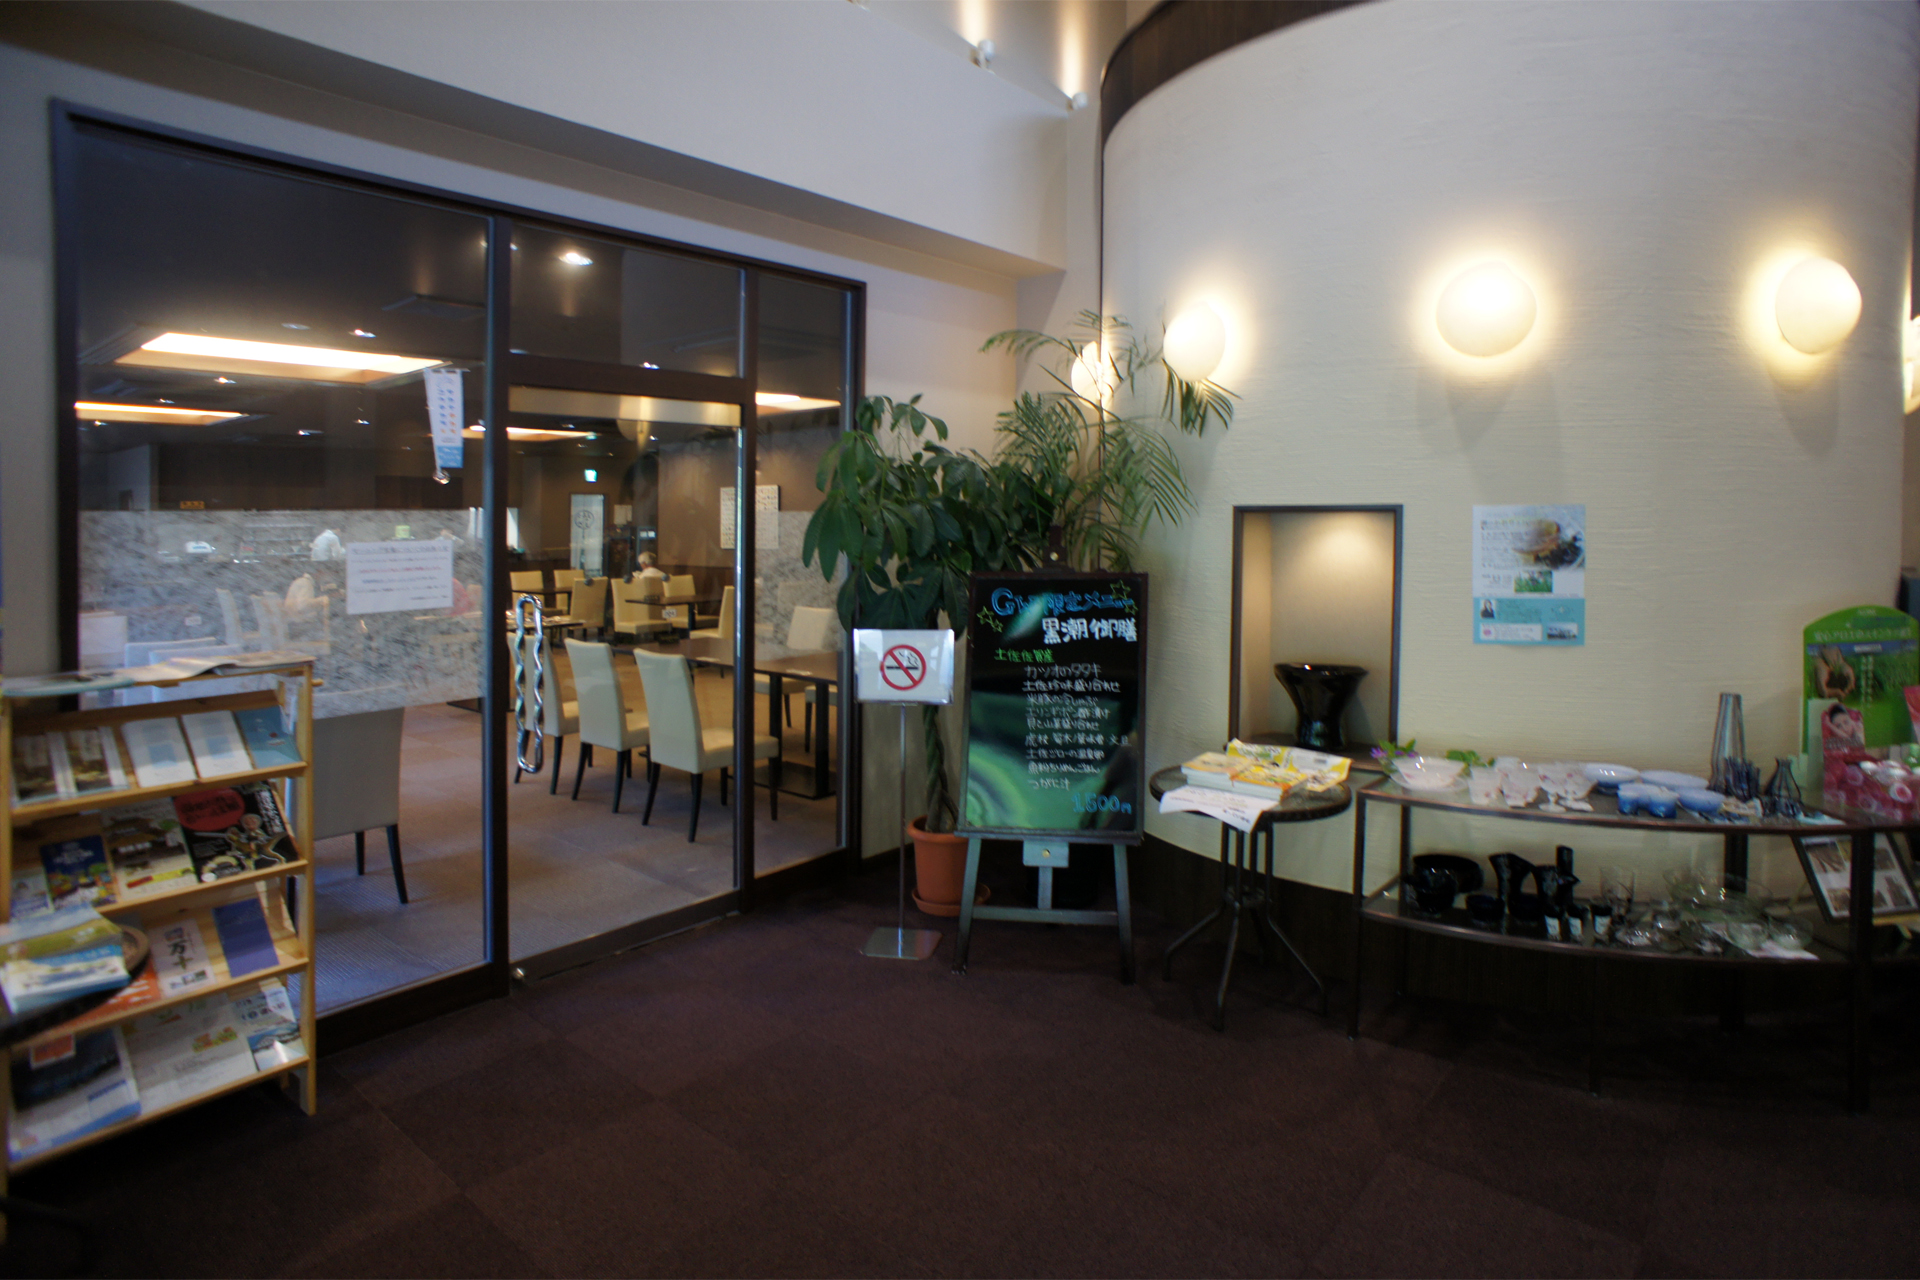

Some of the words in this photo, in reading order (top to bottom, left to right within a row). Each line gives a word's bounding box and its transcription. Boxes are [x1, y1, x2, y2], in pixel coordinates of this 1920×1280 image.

[1041, 616, 1138, 645] 黒潮御膳
[1024, 662, 1102, 679] カツオのタタキ
